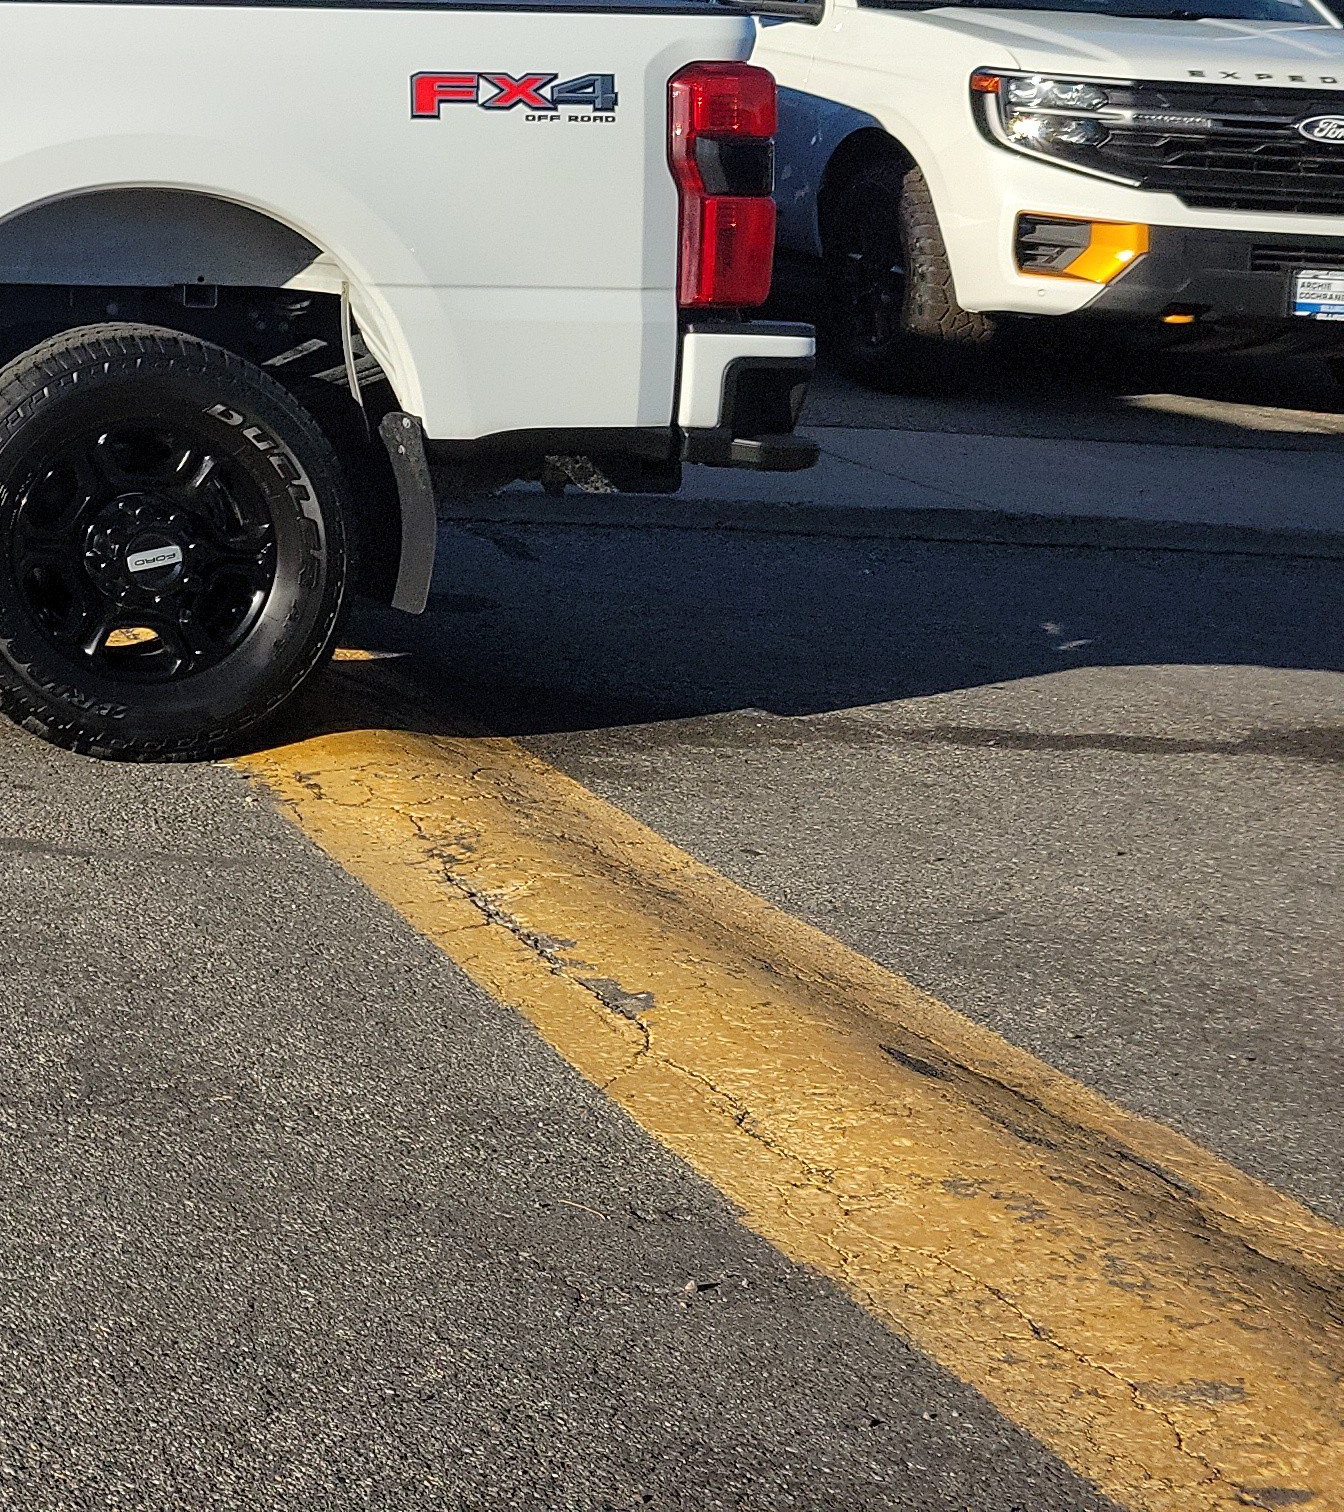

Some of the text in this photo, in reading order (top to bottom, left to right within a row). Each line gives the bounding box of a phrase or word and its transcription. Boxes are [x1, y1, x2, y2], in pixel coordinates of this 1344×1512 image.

[410, 71, 619, 120] FX4
[524, 114, 616, 123] OFF ROAD
[134, 552, 176, 566] FORD
